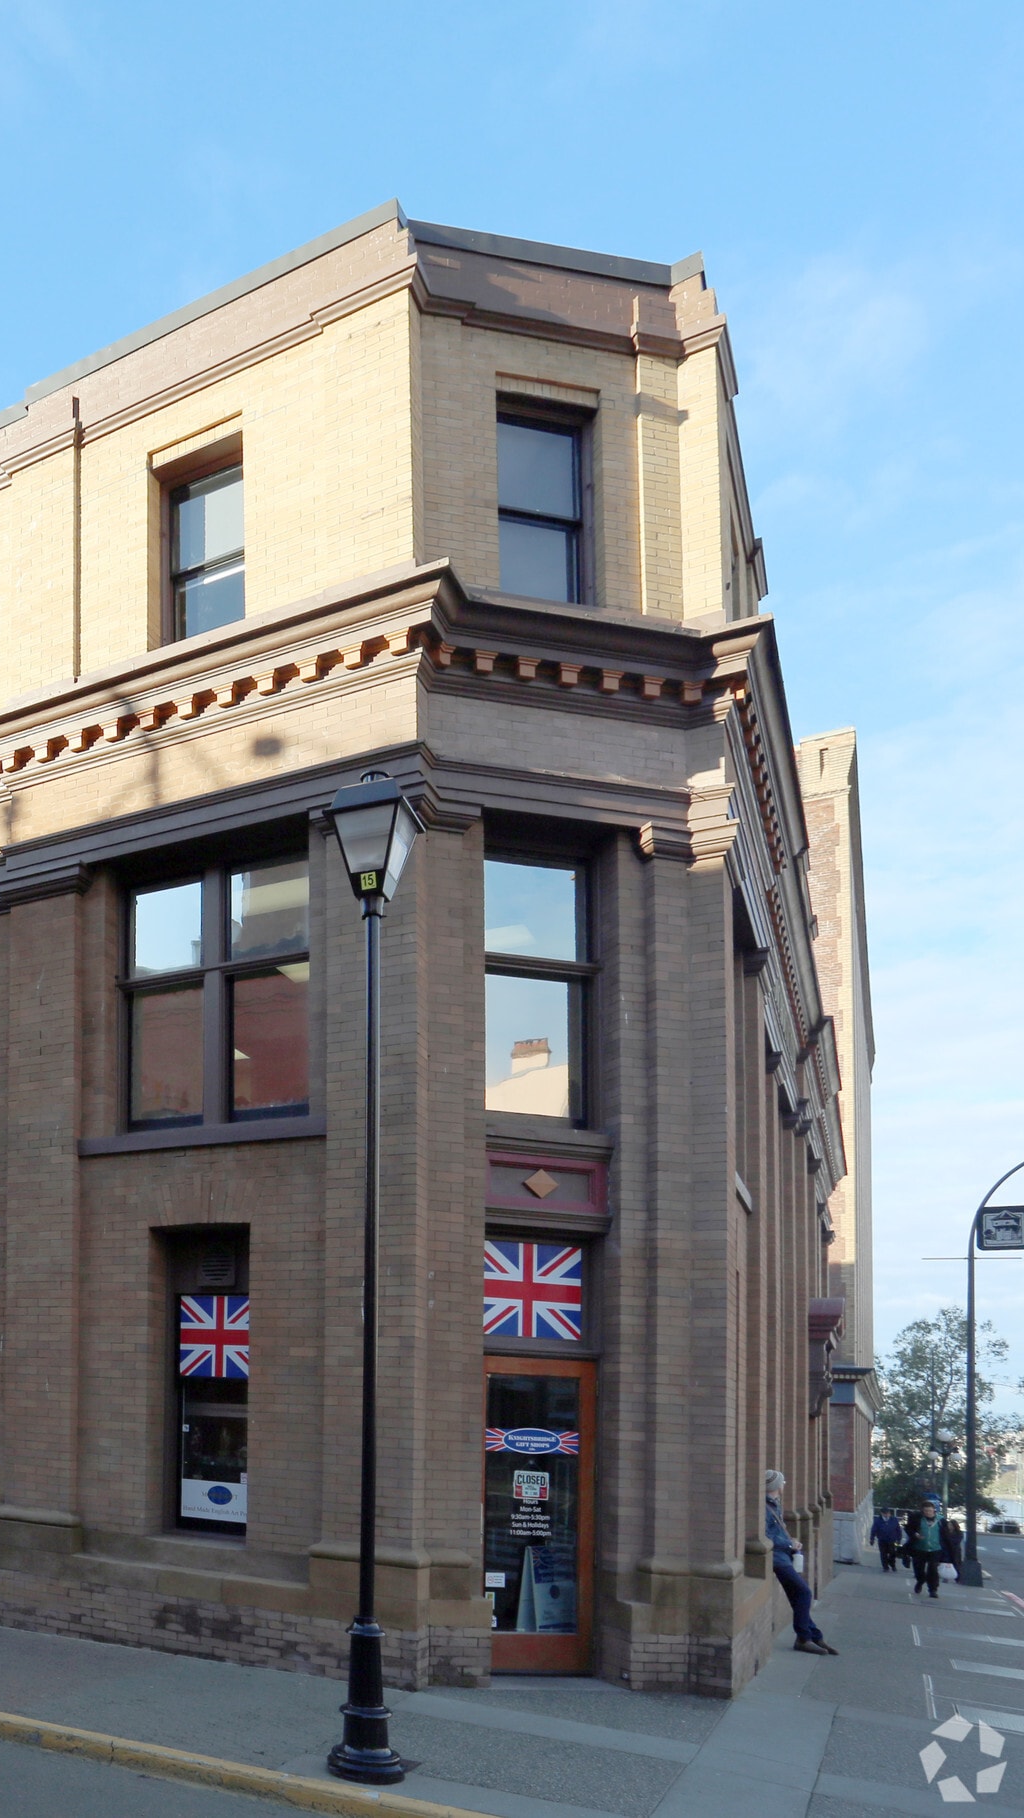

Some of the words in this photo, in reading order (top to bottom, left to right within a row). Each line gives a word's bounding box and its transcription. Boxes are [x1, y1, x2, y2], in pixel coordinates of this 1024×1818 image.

[362, 873, 374, 887] 15
[508, 1434, 557, 1443] KNIGHTSBRIDGE
[517, 1474, 546, 1486] CLOSED
[527, 1521, 549, 1529] Holidays
